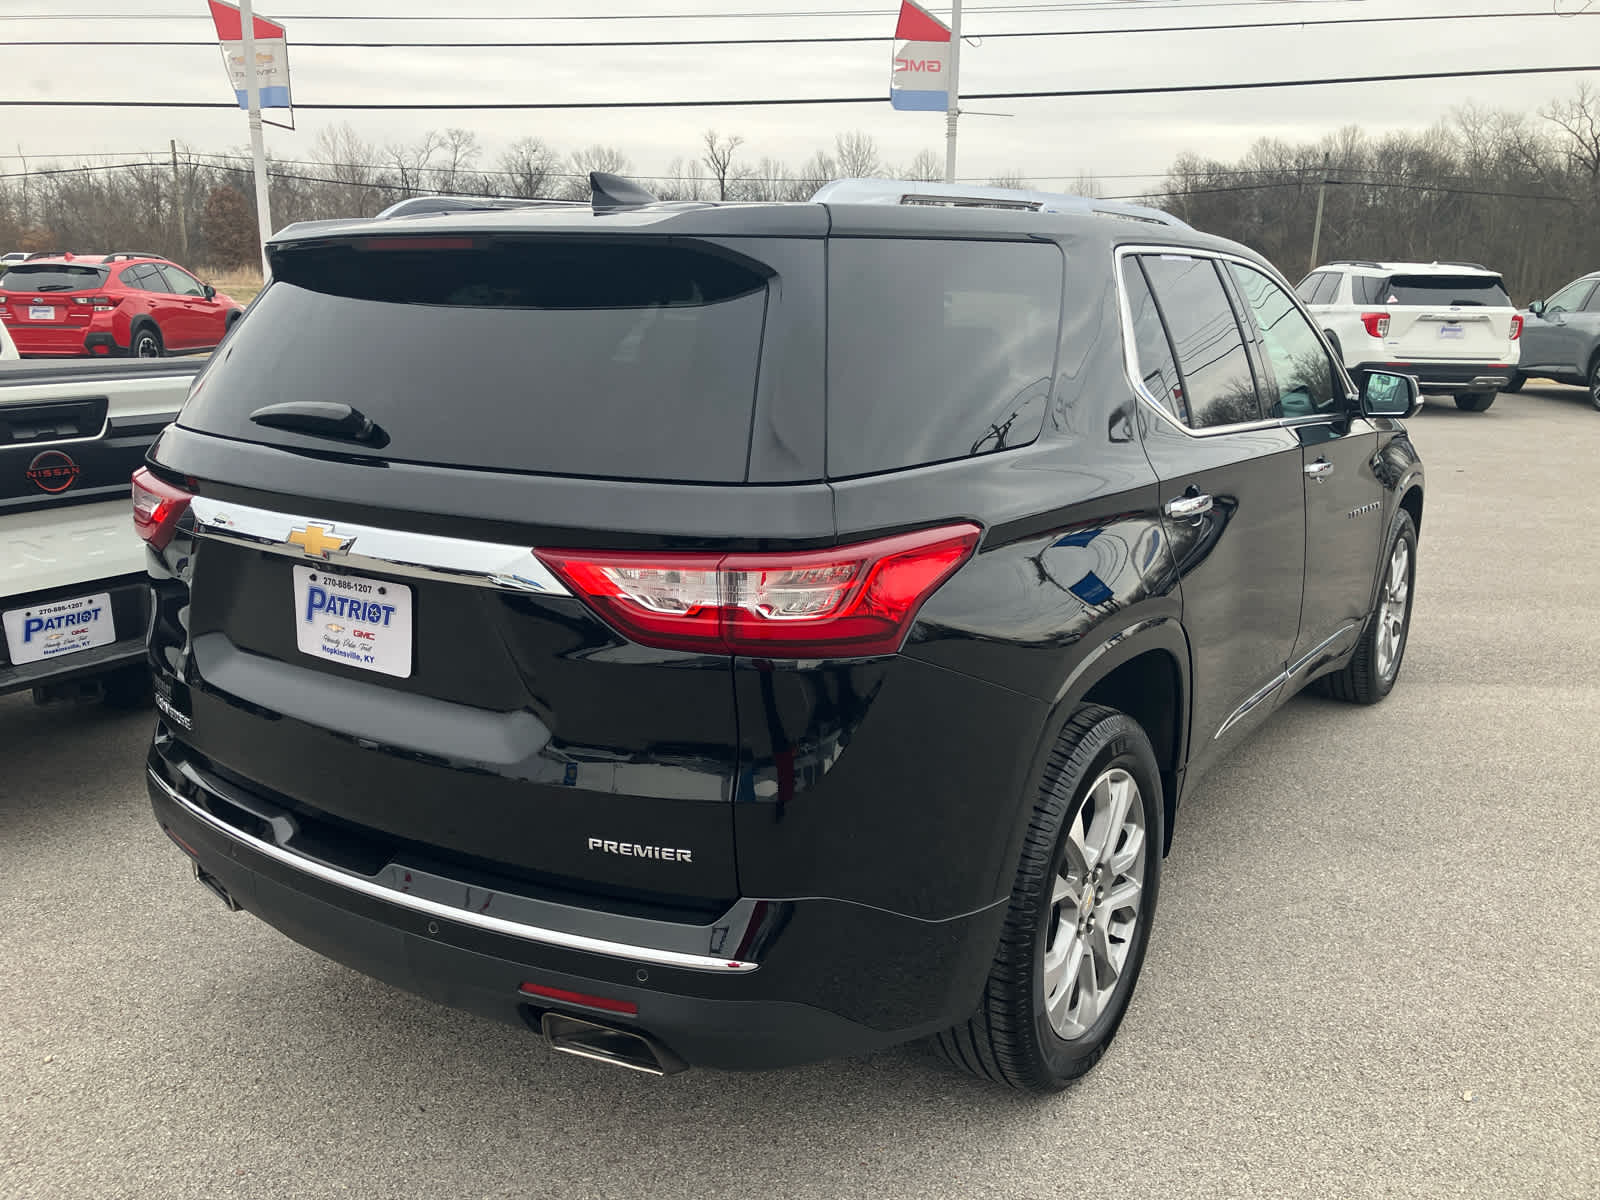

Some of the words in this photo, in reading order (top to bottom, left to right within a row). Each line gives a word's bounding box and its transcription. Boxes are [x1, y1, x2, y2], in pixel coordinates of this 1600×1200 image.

[26, 467, 80, 479] NISSAN
[323, 576, 373, 594] 270-886-1207
[304, 586, 395, 625] PATRIOT
[24, 608, 101, 643] PATRIOT
[353, 629, 375, 640] GMC
[322, 645, 362, 662] Hopkinsville,
[364, 655, 375, 663] KY
[588, 837, 693, 863] PREMIER
